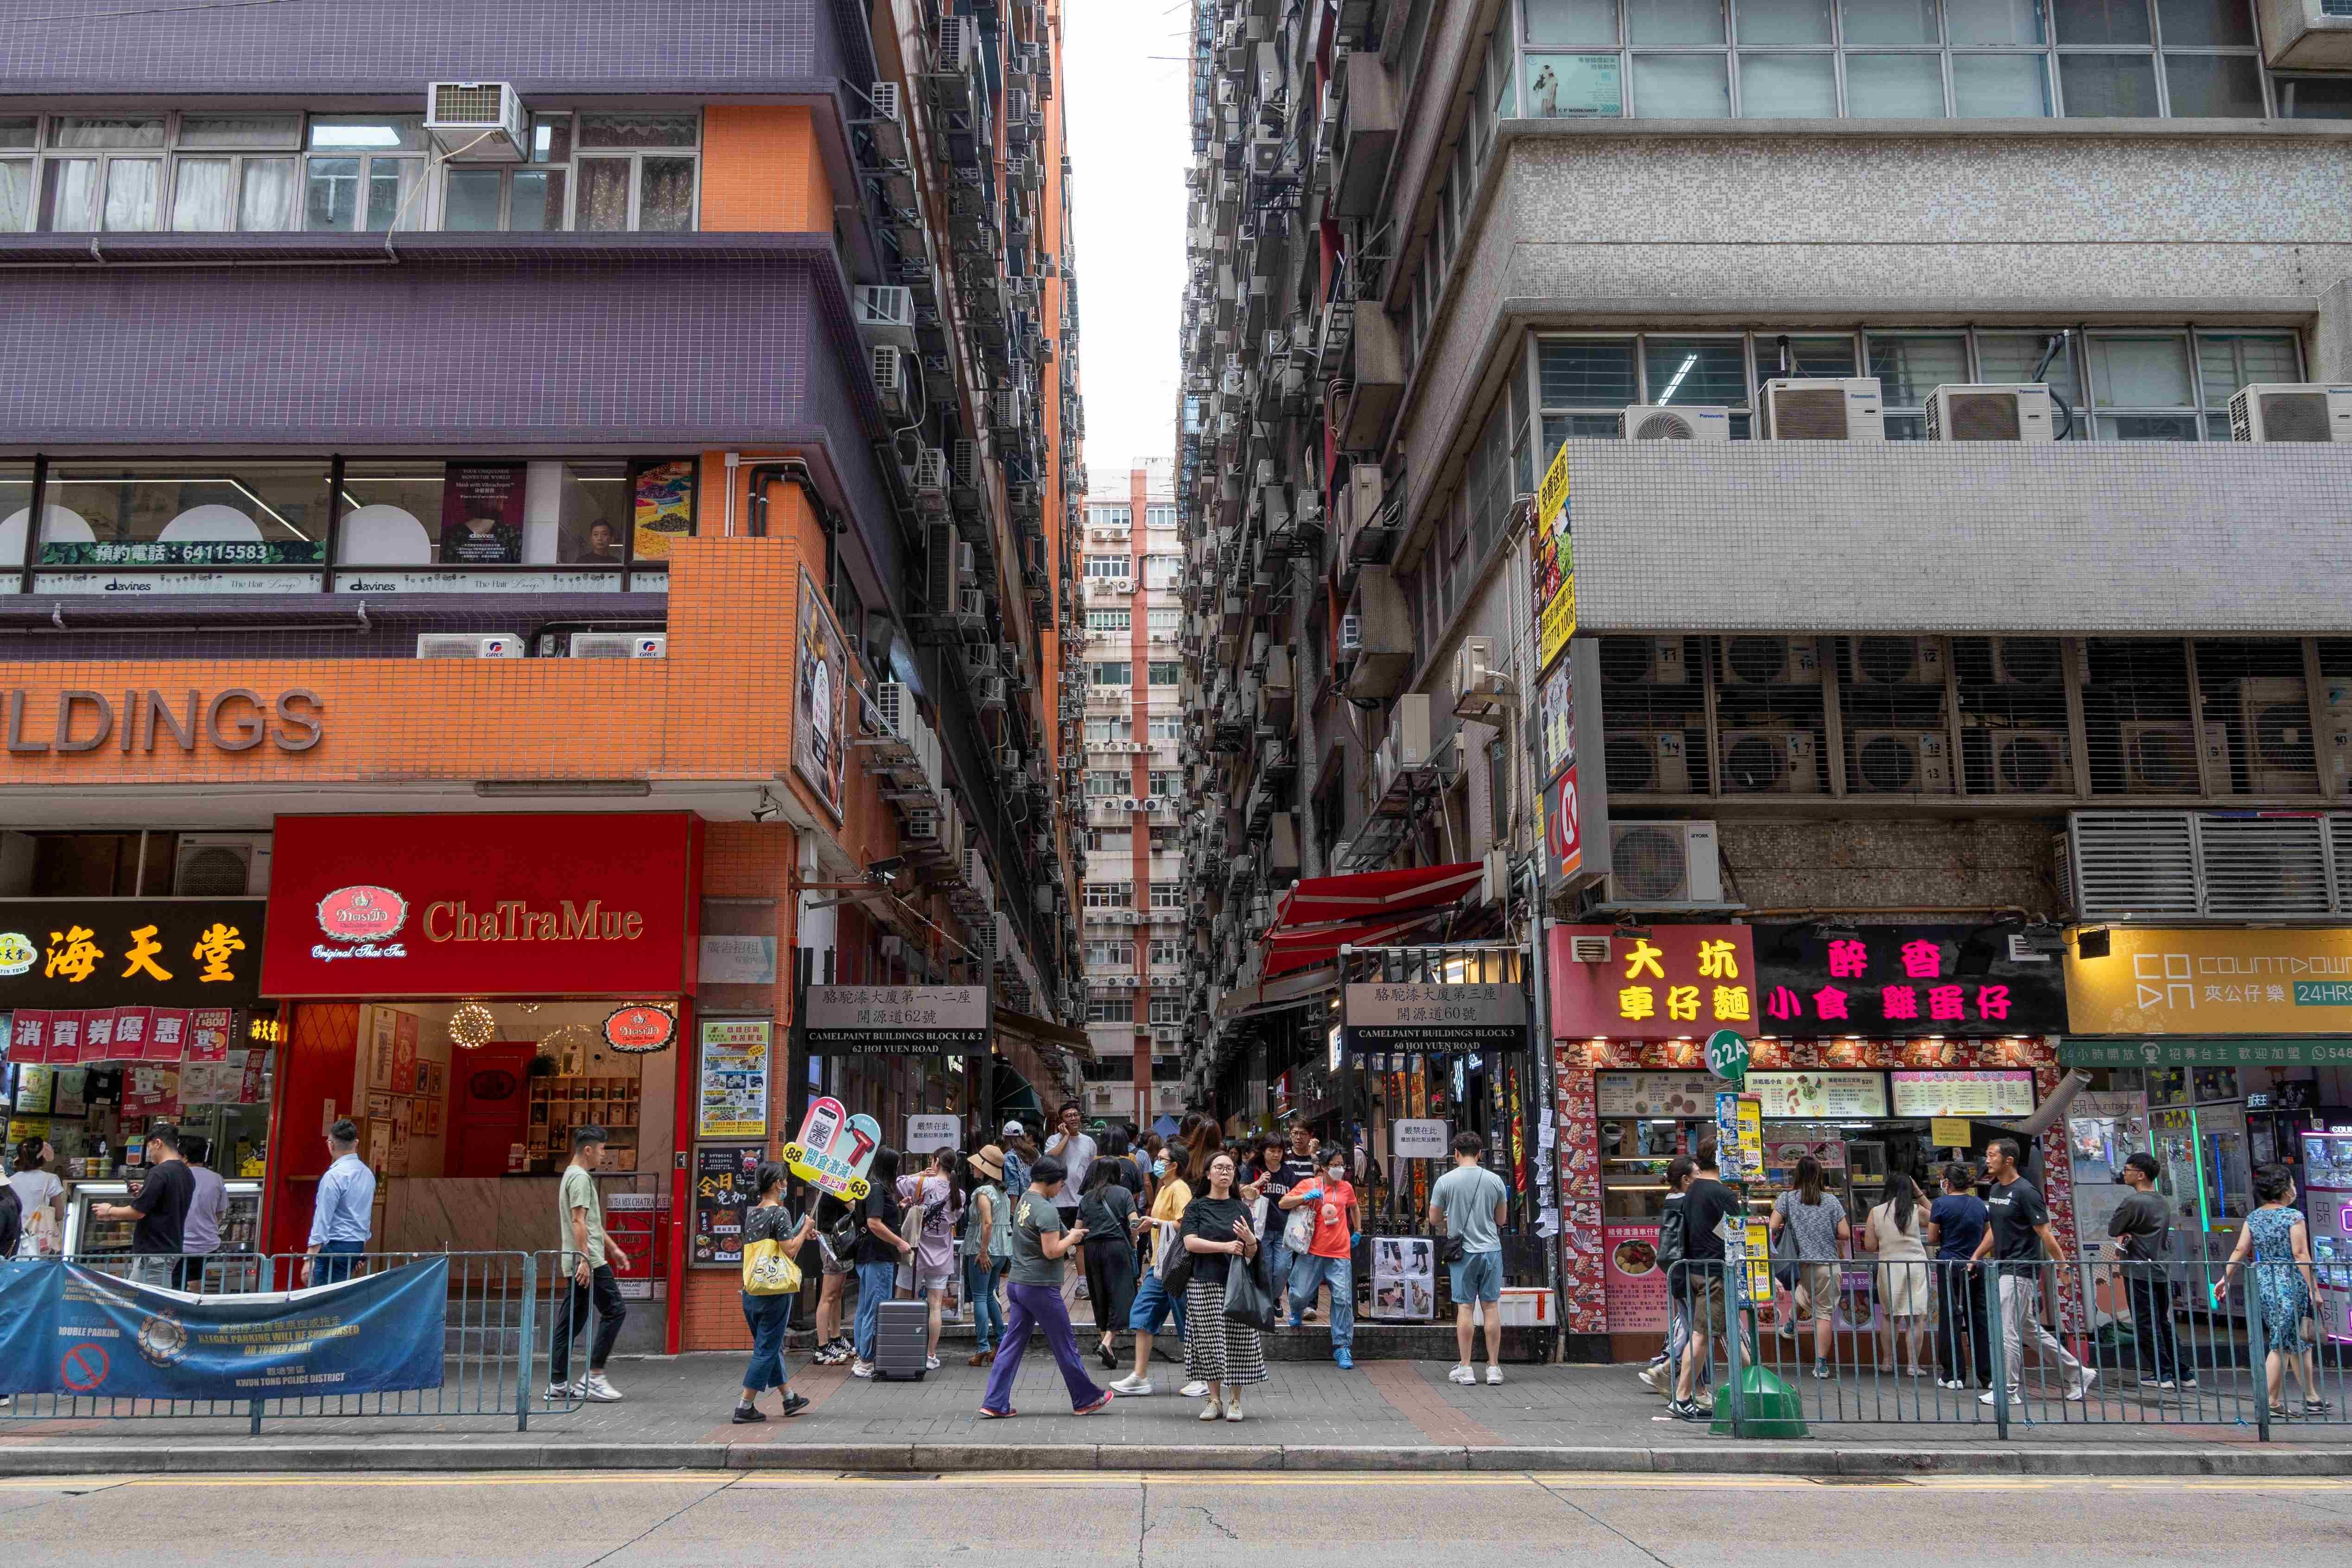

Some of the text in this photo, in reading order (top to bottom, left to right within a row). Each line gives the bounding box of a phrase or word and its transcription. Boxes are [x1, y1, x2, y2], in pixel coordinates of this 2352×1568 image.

[104, 577, 152, 591] davines
[231, 580, 246, 588] The
[248, 580, 263, 588] Hair
[350, 577, 396, 591] davines
[474, 580, 490, 588] The
[492, 580, 508, 588] Hair
[1561, 603, 1574, 635] 1008
[1923, 652, 1936, 662] 12
[0, 688, 323, 751] LDINGS
[1664, 741, 1679, 754] 14
[1565, 792, 1577, 832] K
[423, 899, 643, 942] ChaTraMue
[44, 923, 245, 982] 海天堂
[312, 944, 407, 963] Original Thai Tea
[707, 941, 759, 954] 廣告招租
[1625, 939, 1739, 979] 大坑
[1827, 938, 1941, 979] 醉香
[822, 990, 972, 1005] 駱駝漆大廈第一、二座
[1375, 987, 1498, 1001] 駱駝漆大廈第三座
[2204, 984, 2286, 1002] 夾公仔樂
[1619, 985, 1750, 1021] 車仔麵
[857, 1010, 937, 1024] 開源道62號
[1397, 1007, 1477, 1022] 開源道60號
[15, 1016, 183, 1047] 消費券優惠
[252, 1019, 278, 1042] 海天堂
[1712, 1038, 1749, 1069] 22A
[2061, 1048, 2135, 1061] 24小時開放
[2169, 1047, 2228, 1060] 招募台主
[2238, 1047, 2301, 1060] 歡迎加盟
[917, 1122, 950, 1131] 嚴禁在此
[1404, 1126, 1437, 1135] 嚴禁在此
[784, 1147, 803, 1163] $88
[697, 1172, 733, 1197] 全日
[820, 1174, 847, 1192] 即上2樓
[849, 1181, 868, 1196] $68
[622, 1197, 632, 1206] MIX
[87, 1327, 120, 1338] PARKING
[198, 1325, 360, 1343] ILLEGAL PARKING WILL BE SUMMONSED
[245, 1341, 313, 1354] OR TOWED AWAY
[236, 1373, 345, 1387] KWUN TONG POLICE DISTRICT
